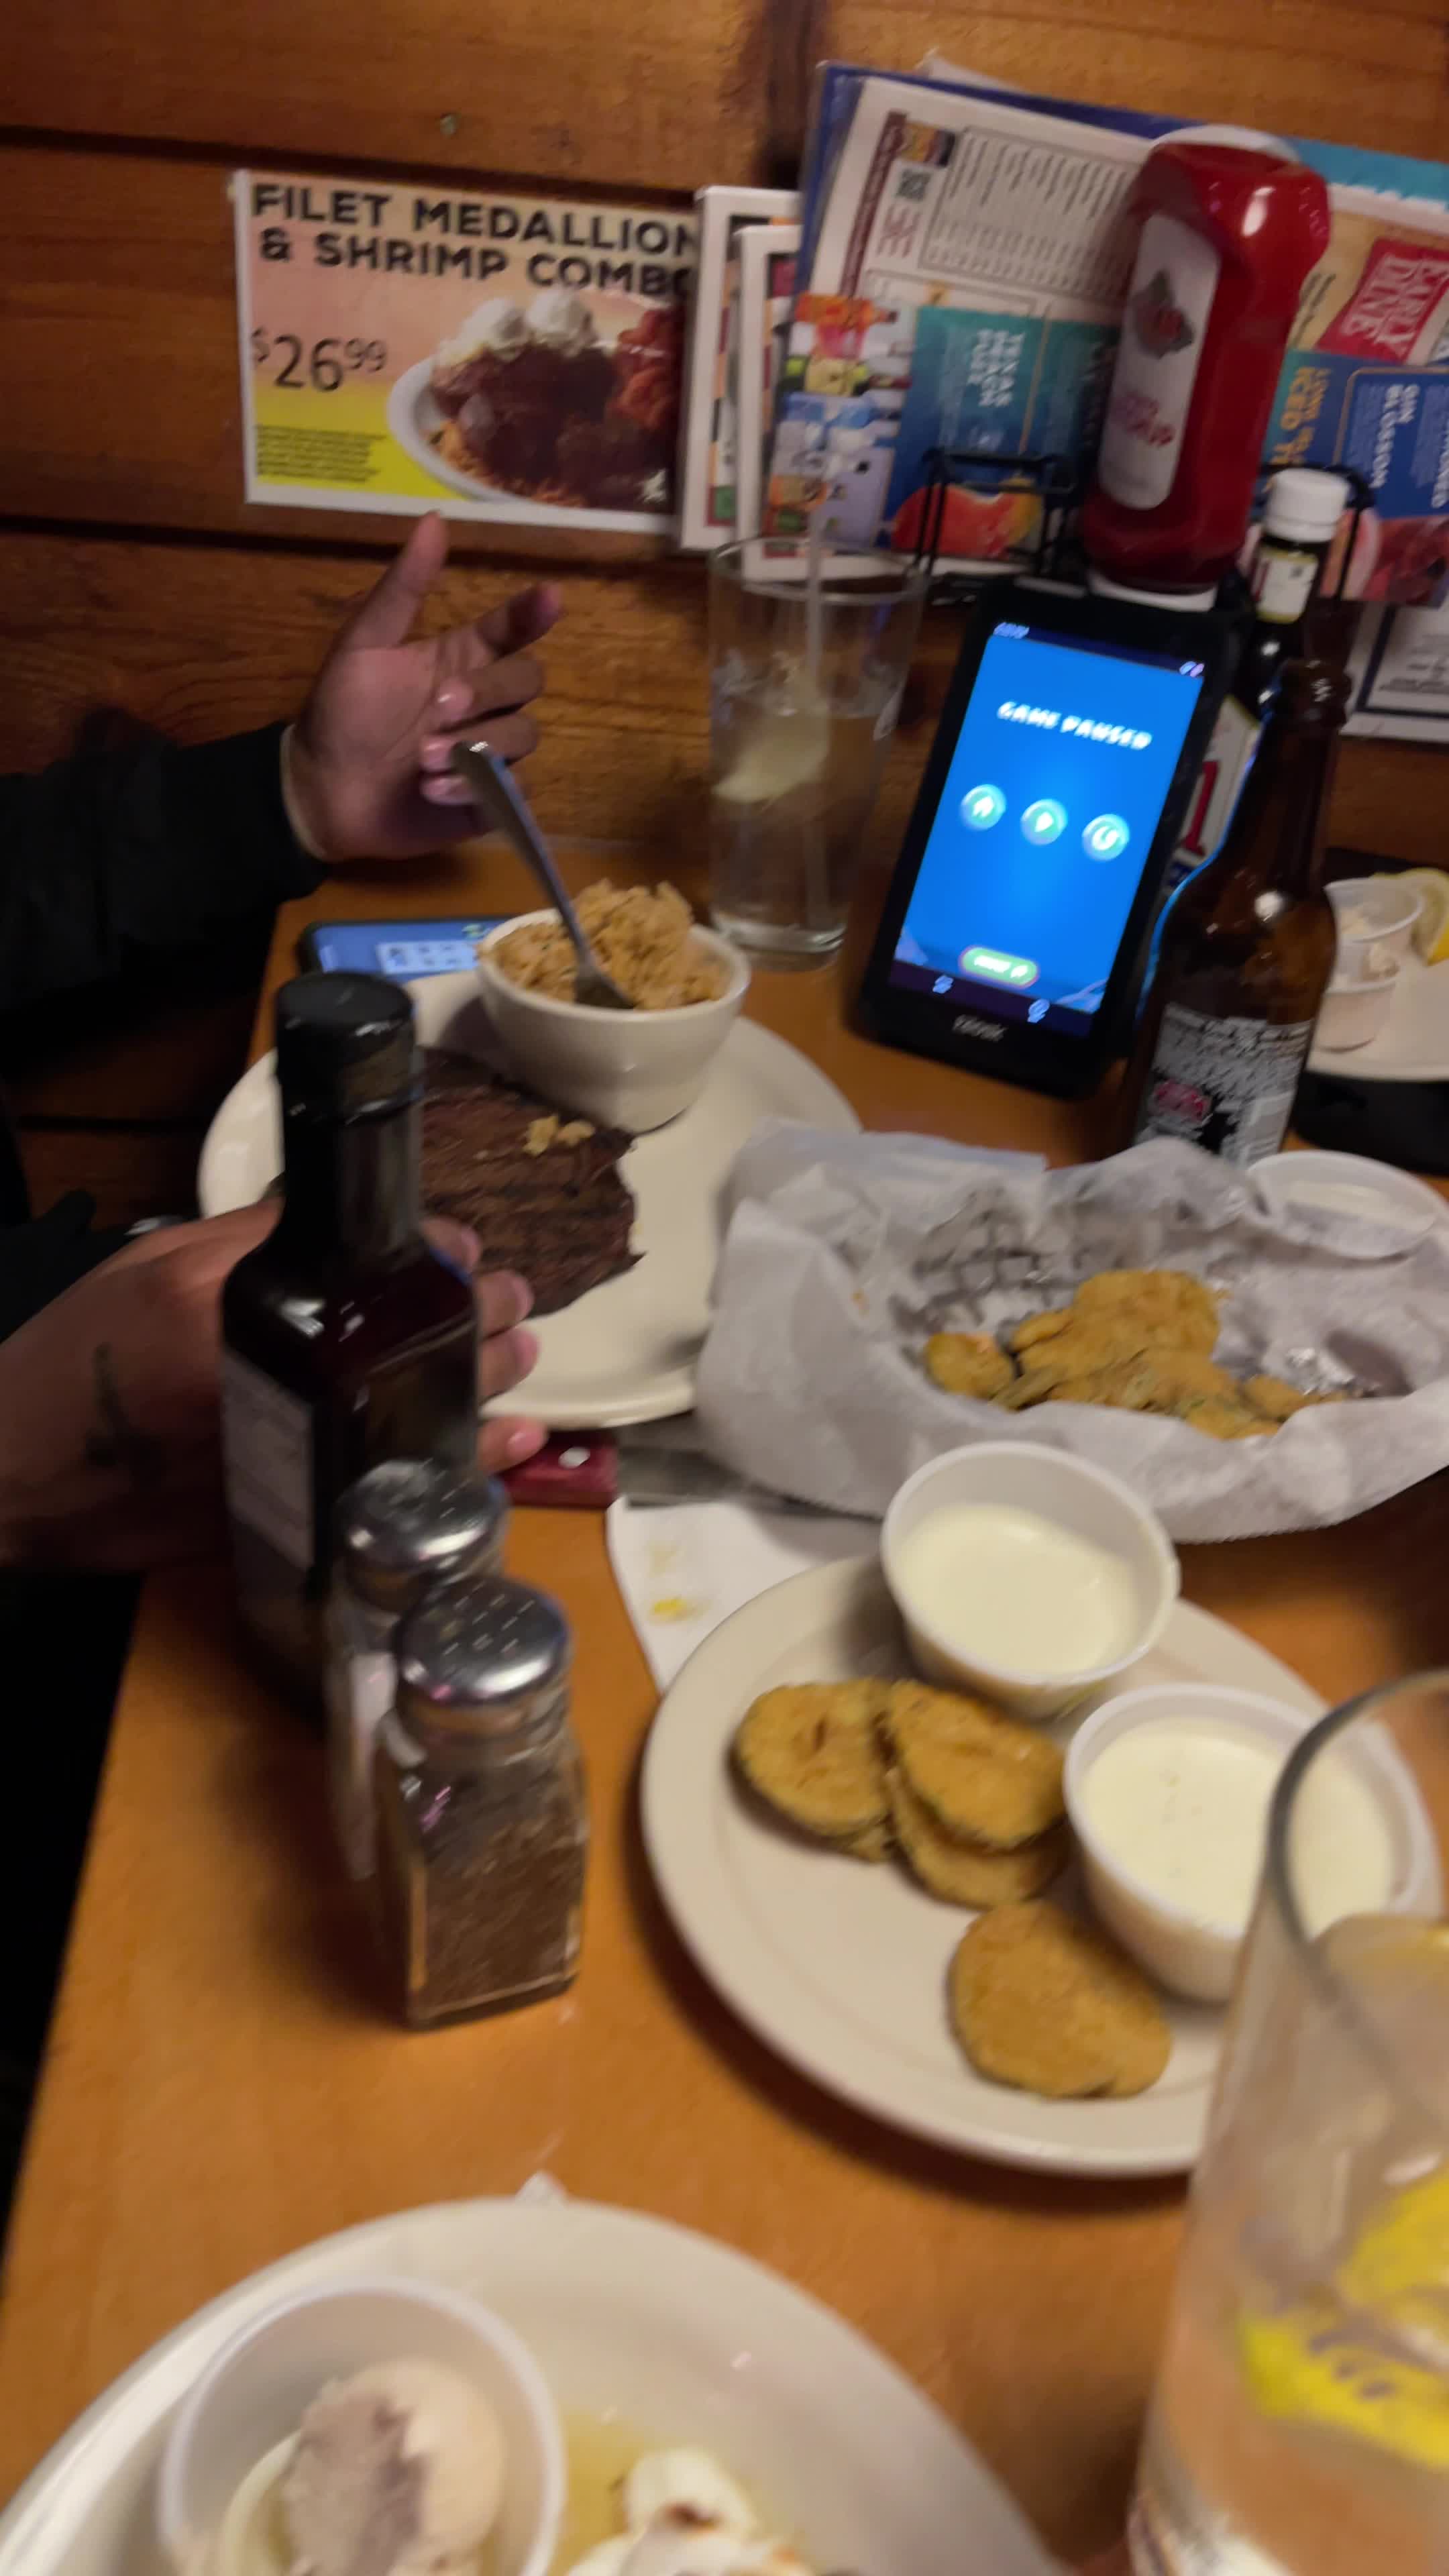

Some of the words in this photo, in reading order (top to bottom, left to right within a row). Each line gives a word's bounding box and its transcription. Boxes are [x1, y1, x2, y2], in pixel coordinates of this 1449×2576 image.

[253, 183, 392, 227] FILET
[260, 227, 291, 261] &
[315, 231, 508, 280] SHRIMP
[996, 700, 1062, 730] GAME
[1059, 714, 1153, 751] PAUSED
